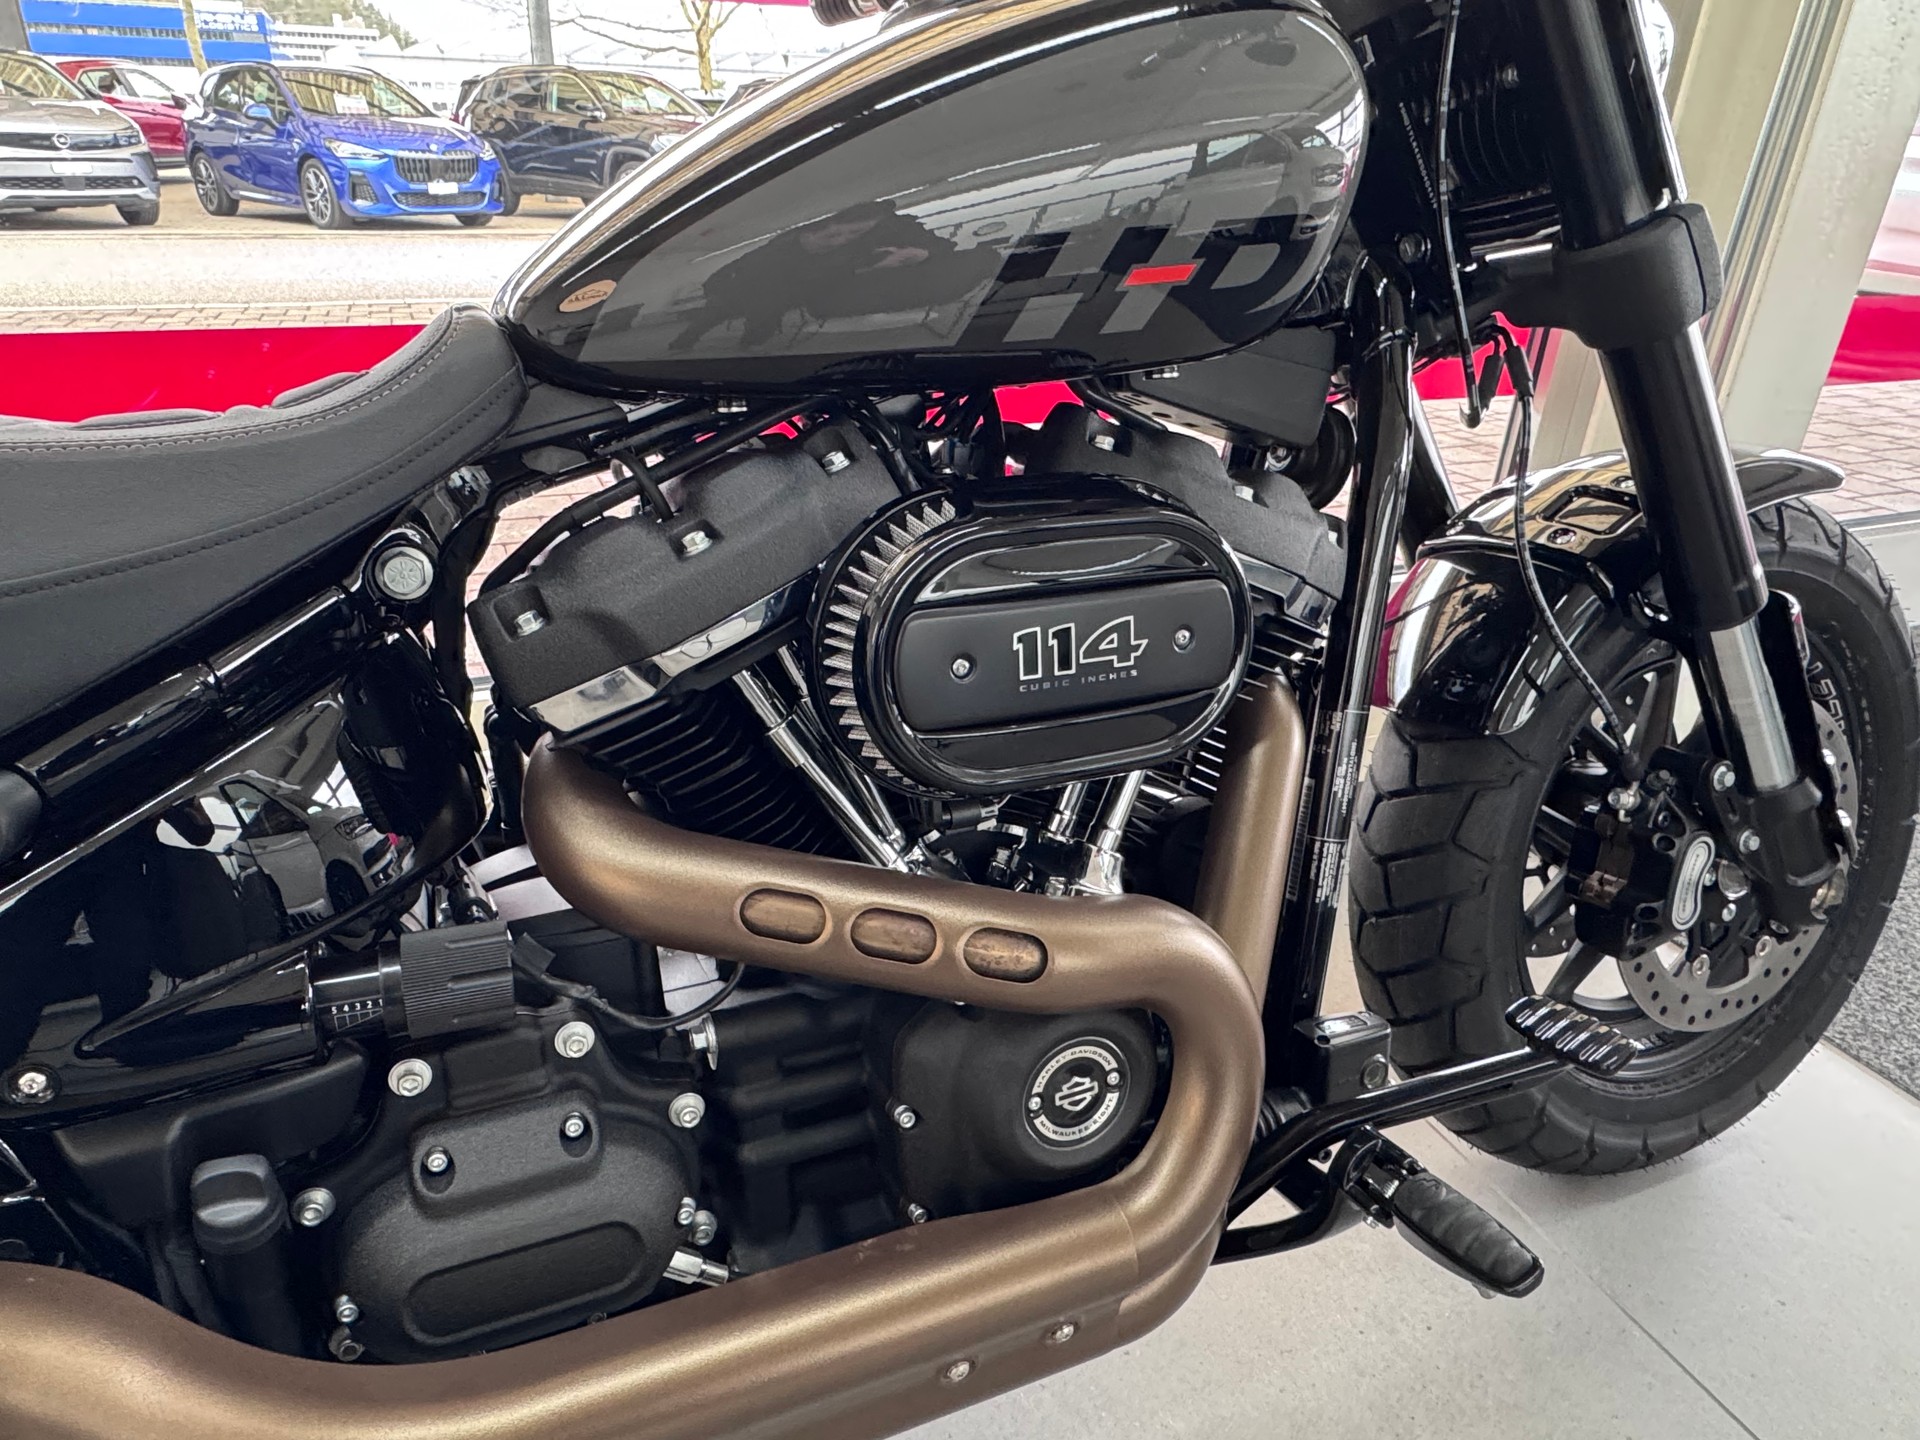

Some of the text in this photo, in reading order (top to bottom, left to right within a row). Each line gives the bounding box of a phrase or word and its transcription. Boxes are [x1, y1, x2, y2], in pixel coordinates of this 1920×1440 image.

[1013, 615, 1148, 680] 114
[1019, 669, 1138, 692] CUBIC INCHES
[331, 1006, 337, 1014] 5
[343, 1004, 349, 1012] 4
[366, 1001, 372, 1009] 2
[1036, 1049, 1113, 1089] HARLEY-DAVIDSON
[1039, 1096, 1114, 1137] MILWAUKEE-EIGHT
